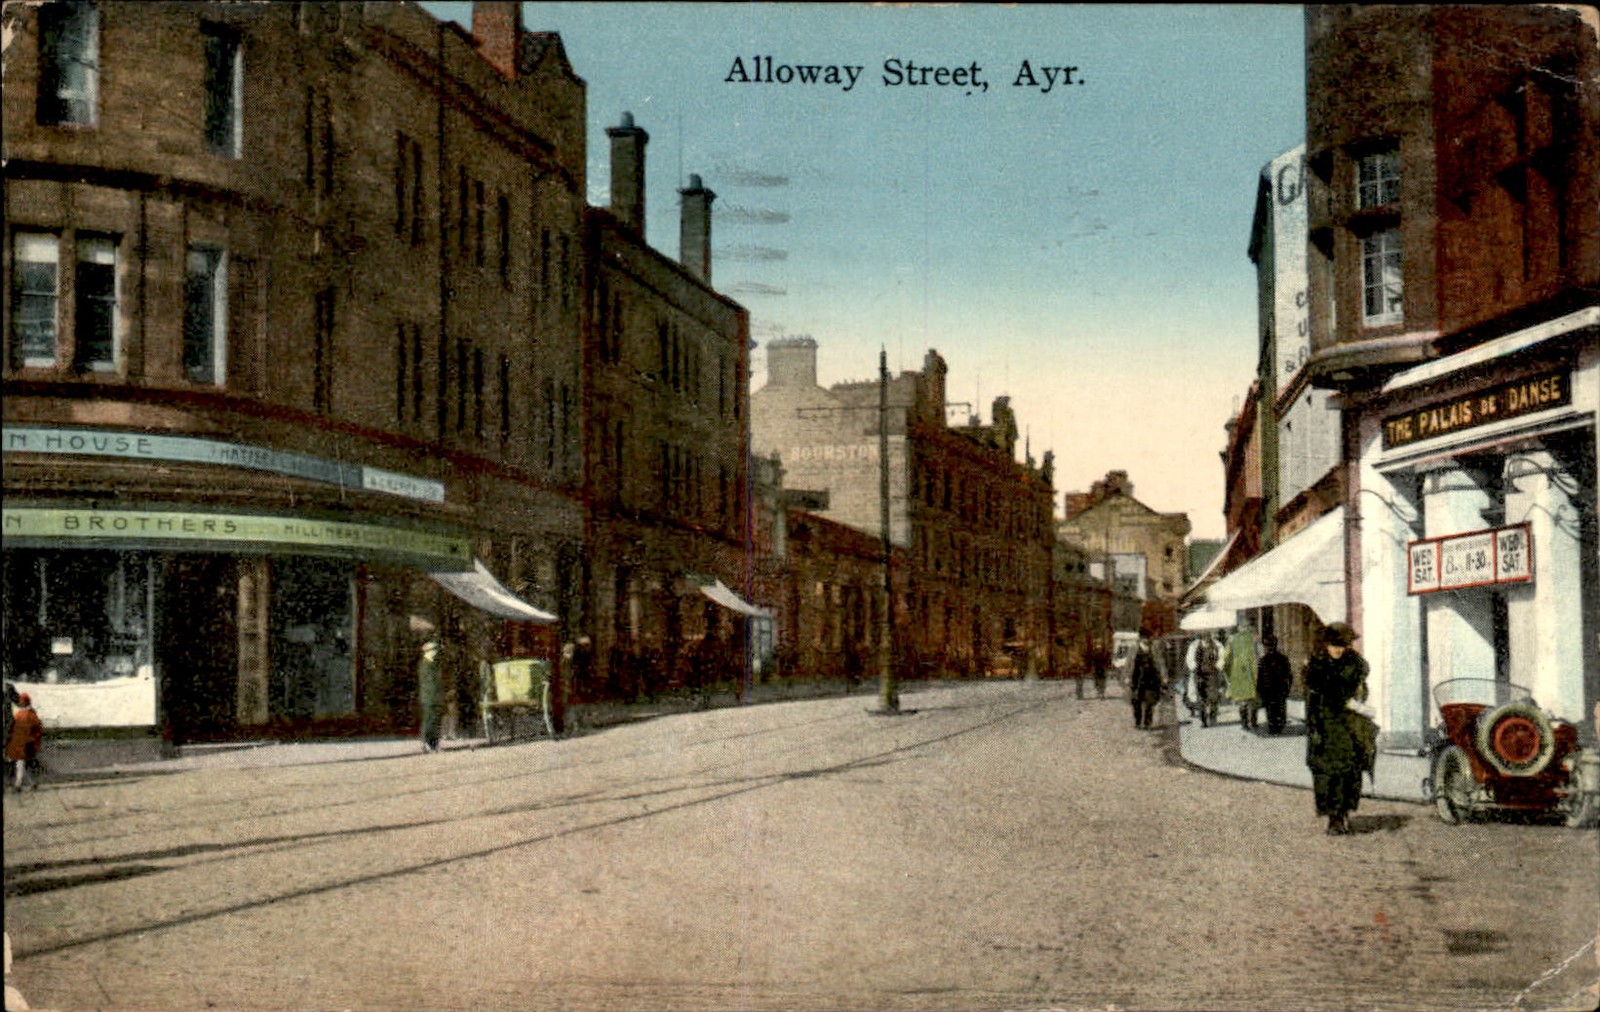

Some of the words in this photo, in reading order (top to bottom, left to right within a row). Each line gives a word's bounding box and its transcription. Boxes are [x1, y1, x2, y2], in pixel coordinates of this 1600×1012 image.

[1388, 417, 1413, 445] THE
[1419, 401, 1472, 433] PALAIS
[1509, 375, 1561, 411] DANSE
[46, 435, 152, 454] HOUSE
[64, 516, 237, 533] BROTHERS
